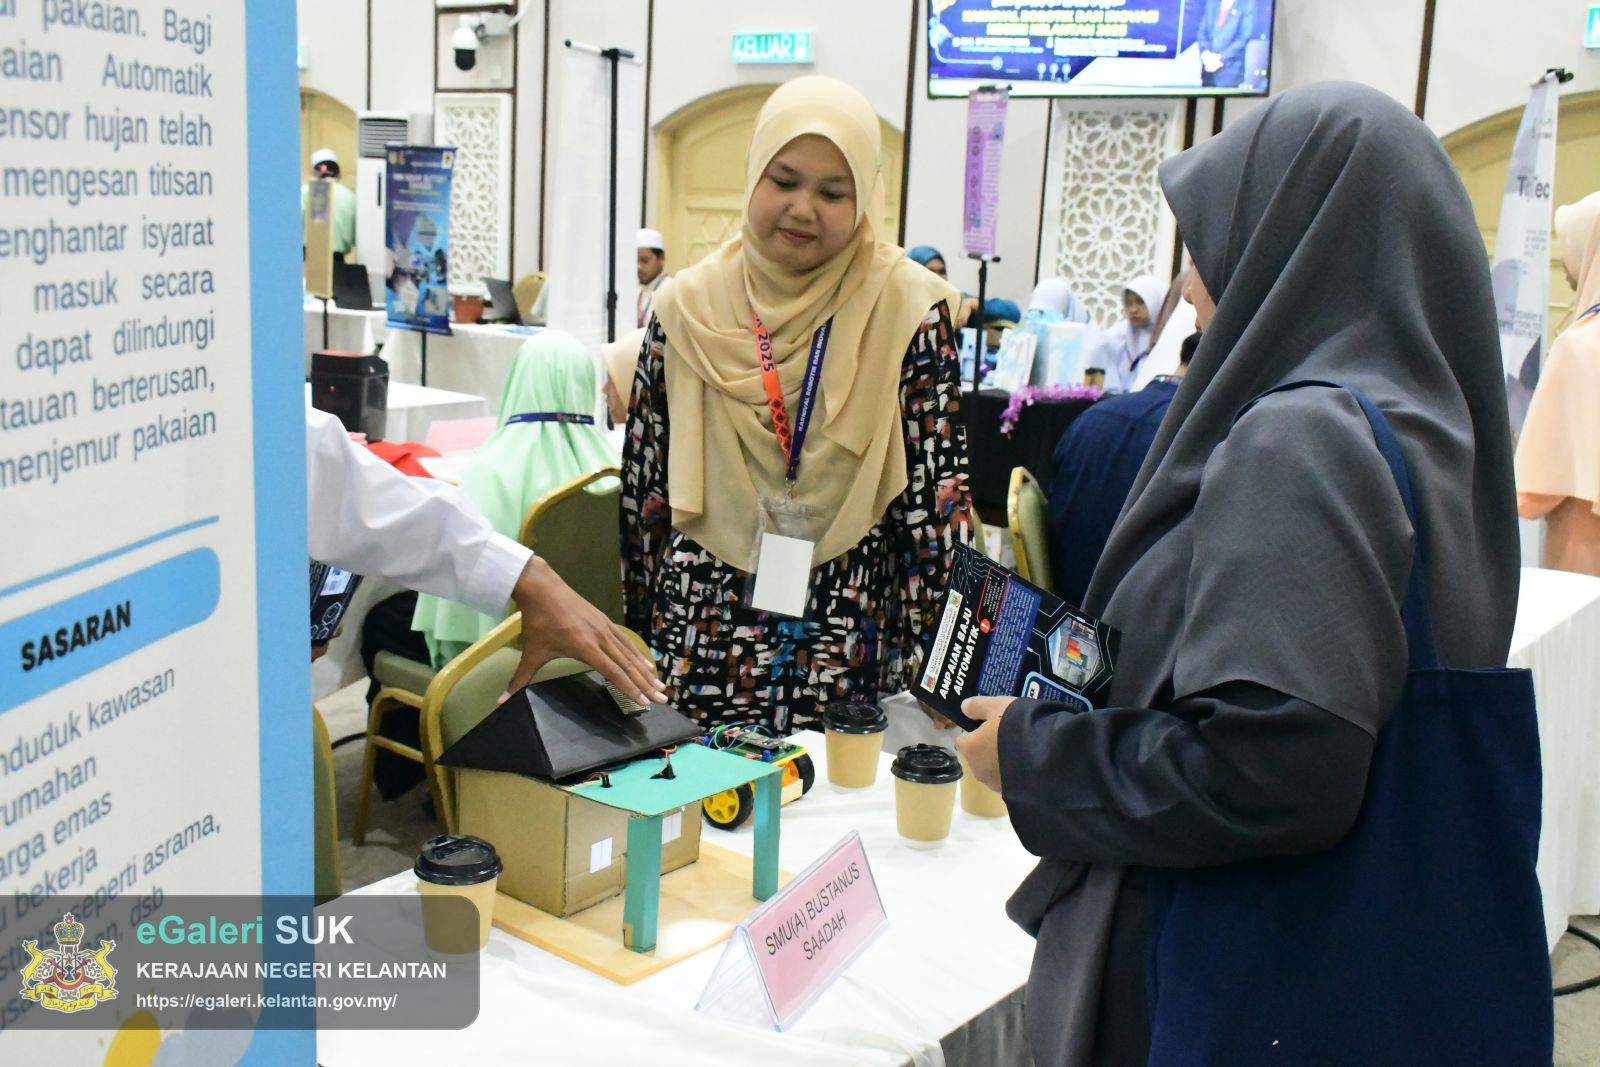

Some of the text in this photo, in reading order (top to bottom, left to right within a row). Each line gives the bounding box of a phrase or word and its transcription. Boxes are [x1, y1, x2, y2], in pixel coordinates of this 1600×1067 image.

[43, 0, 146, 37] pakaian.
[163, 9, 211, 54] Bagi
[734, 35, 793, 59] KELUAR
[2, 41, 213, 97] aian Automatik
[85, 105, 148, 151] hujan
[159, 113, 212, 147] telah
[4, 162, 213, 206] mengesan titisan
[142, 215, 214, 256] isyarat
[34, 268, 215, 313] masuk secara
[16, 310, 215, 376] dapat dilindungi
[758, 332, 775, 372] 2025
[0, 364, 215, 431] tauan berterusan,
[799, 323, 828, 432] KARNIVAL ROBOTIK DAN INOVA
[133, 408, 217, 461] pakaian
[20, 600, 132, 672] SASARAN
[938, 642, 966, 700] AMPAIAN
[956, 607, 973, 642] BAJU
[952, 626, 981, 697] AUTOMATIK
[87, 667, 176, 732] kawasan
[52, 791, 113, 846] emas
[143, 813, 220, 875] asrama,
[15, 847, 98, 920] bekerja
[129, 885, 164, 928] dsb
[765, 861, 861, 956] SMU(A) BUSTANUS
[802, 909, 848, 961] SAADAH
